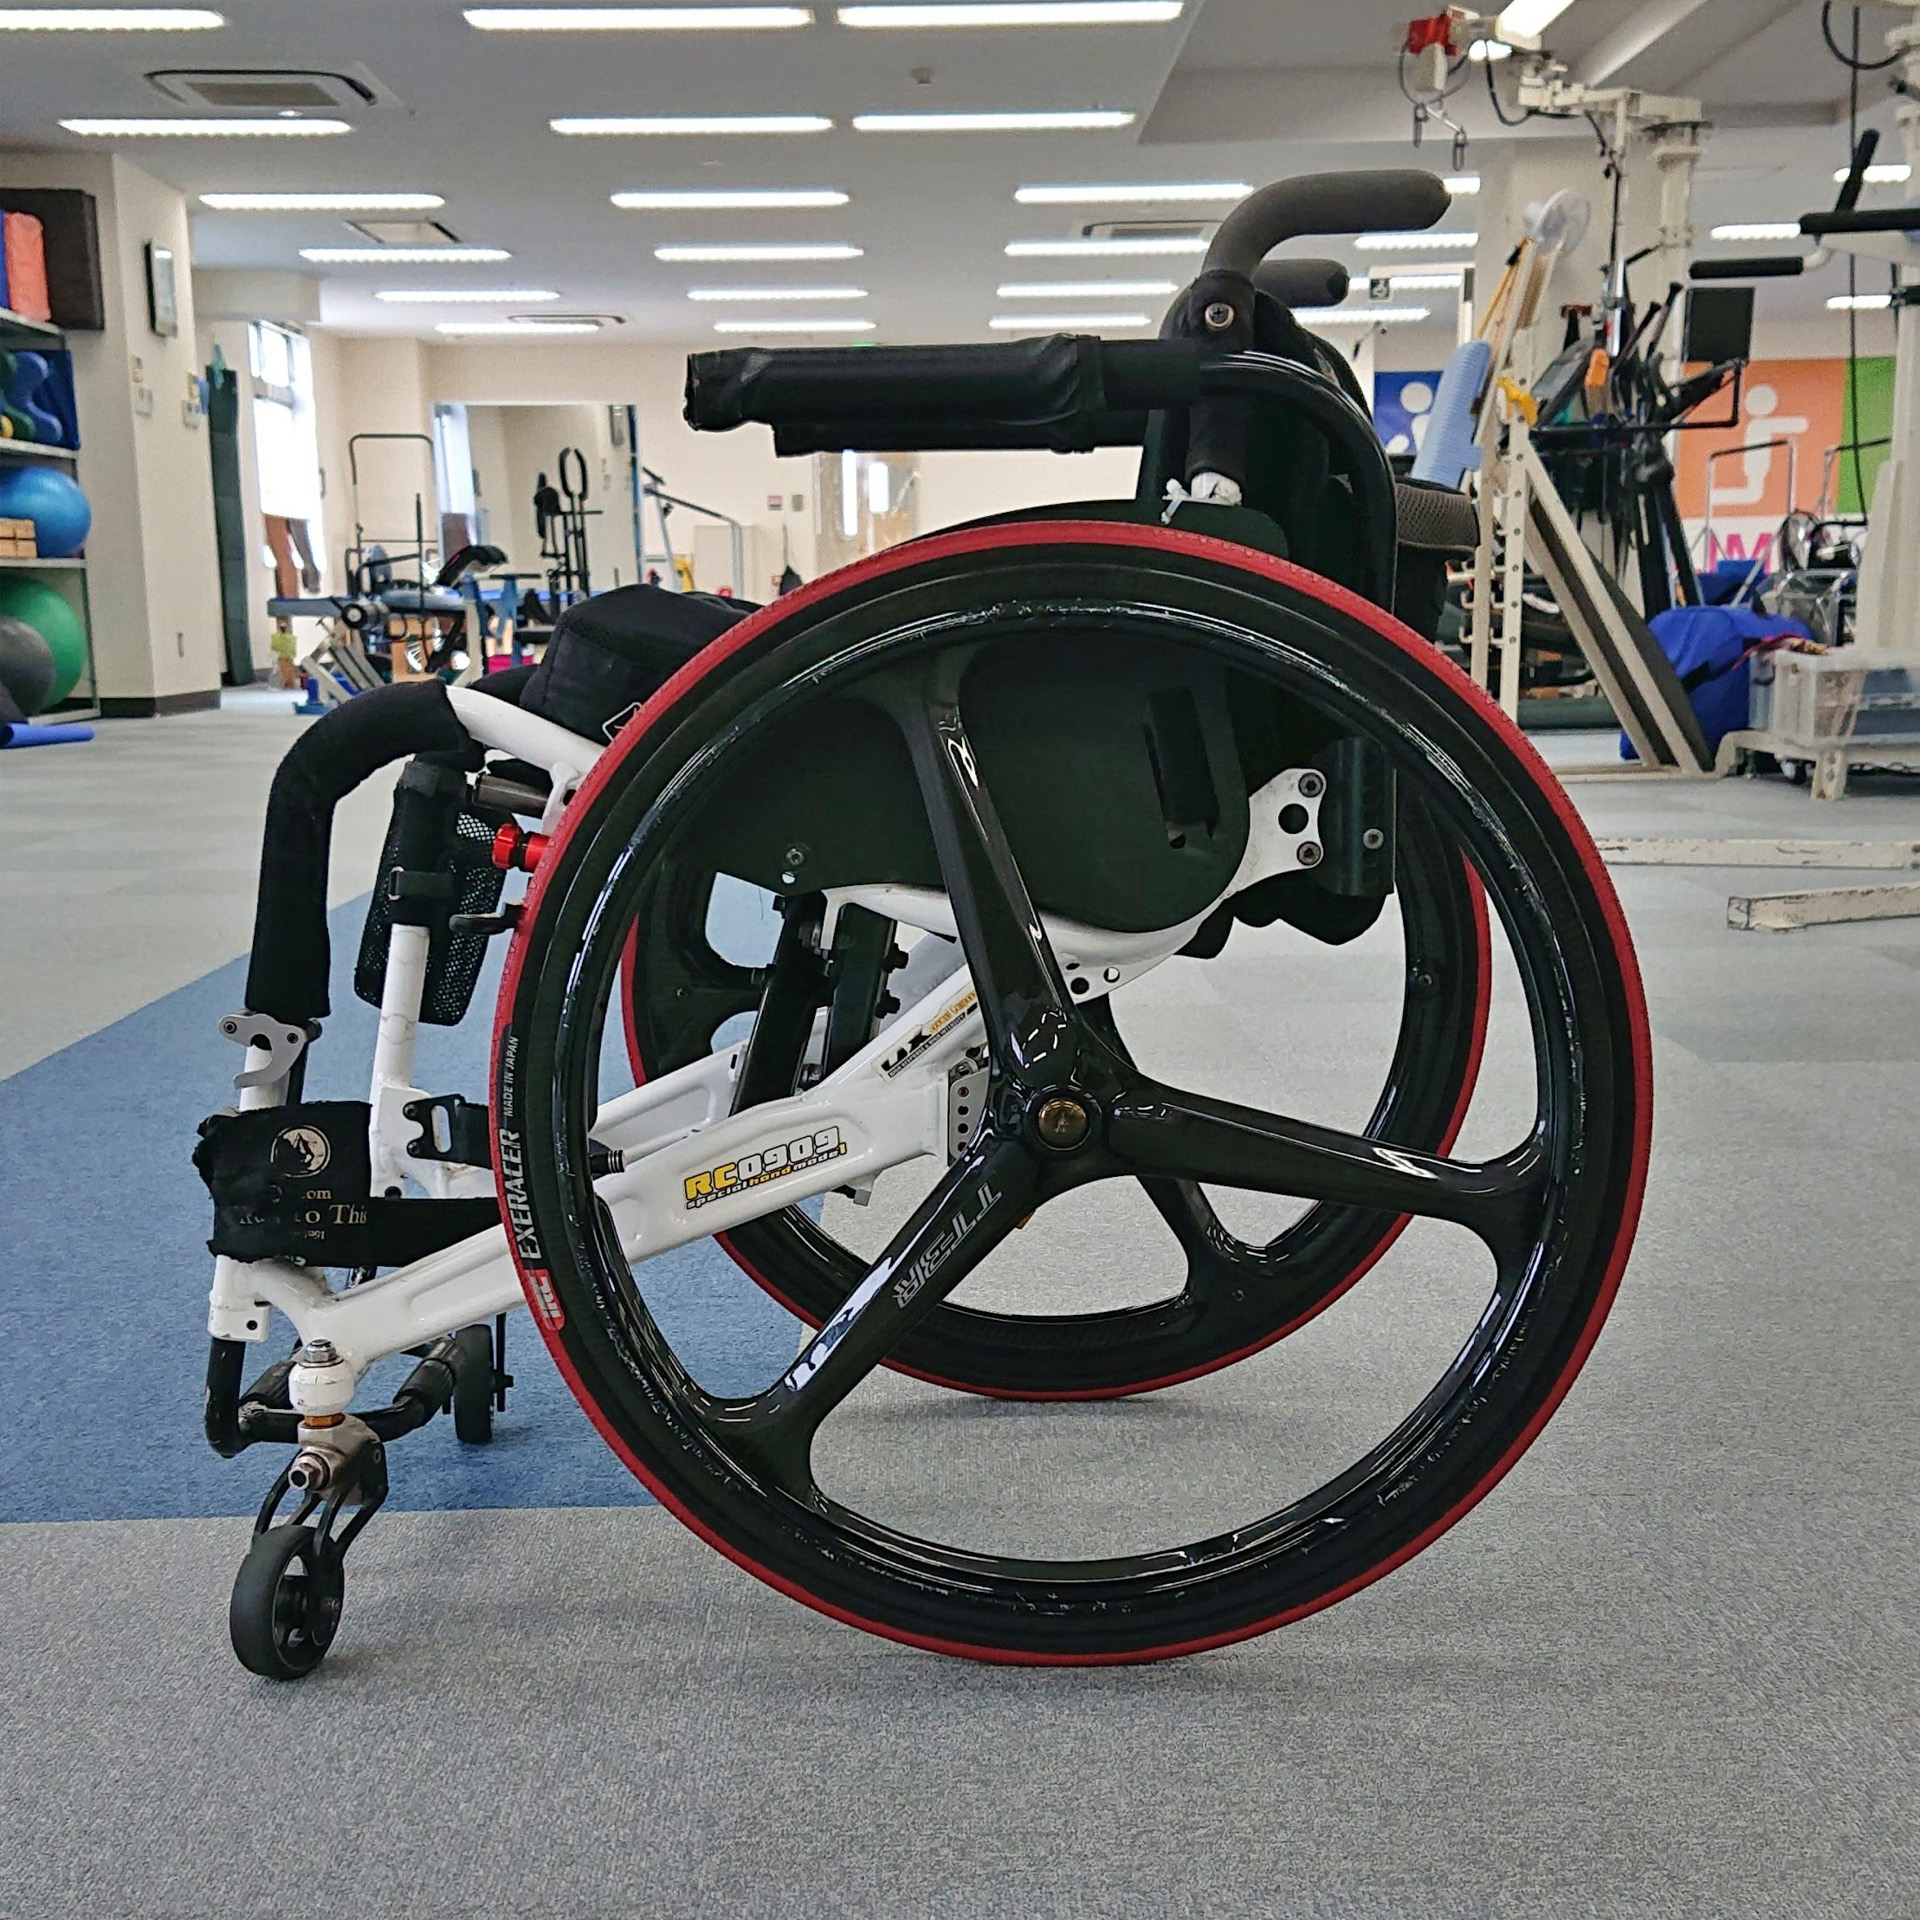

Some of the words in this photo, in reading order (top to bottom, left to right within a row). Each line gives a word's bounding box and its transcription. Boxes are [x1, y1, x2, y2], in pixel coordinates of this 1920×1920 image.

[505, 1036, 520, 1070] JAPAN
[503, 1071, 514, 1084] IN
[503, 1085, 514, 1117] MADE
[684, 1125, 840, 1200] RC0909
[499, 1128, 542, 1259] EXERACER
[328, 1204, 368, 1225] This
[530, 1275, 562, 1319] IRC
